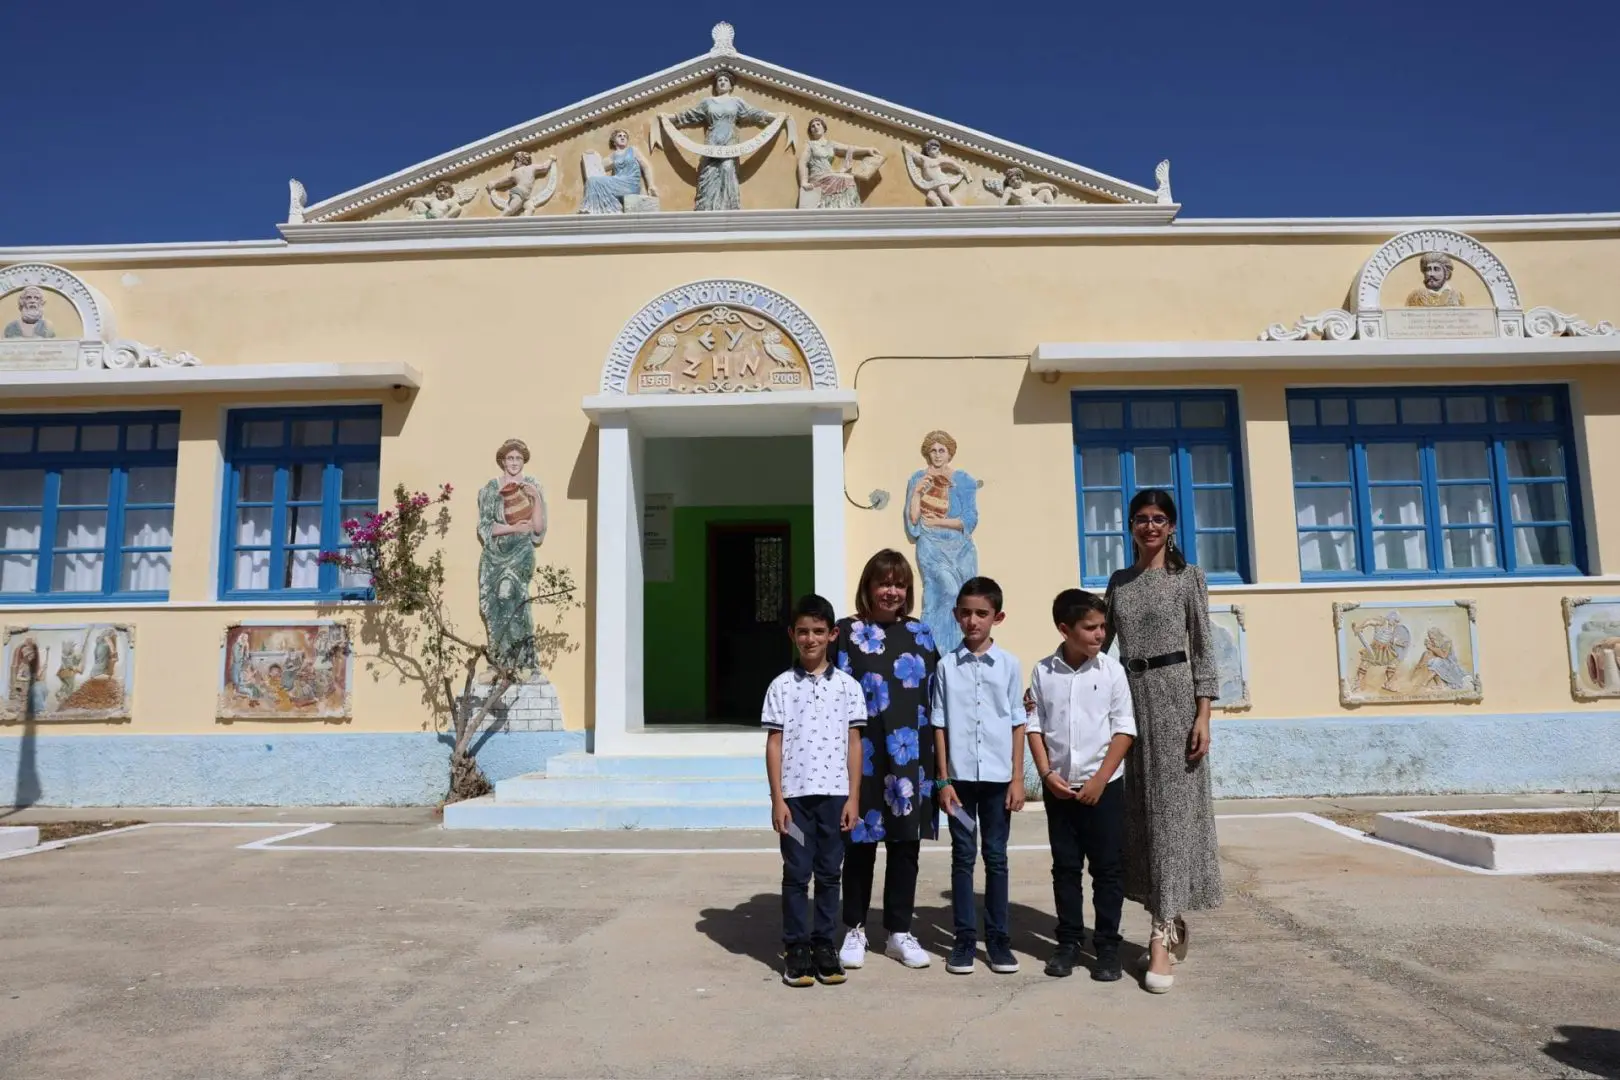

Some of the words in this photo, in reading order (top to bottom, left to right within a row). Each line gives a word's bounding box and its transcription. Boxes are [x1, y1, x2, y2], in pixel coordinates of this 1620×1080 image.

[608, 306, 666, 393] ΔΗΜΟΤΙΚΟ
[674, 289, 758, 313] ΣΧΟΛΕΙΟ
[682, 355, 761, 380] ΖΗΝ
